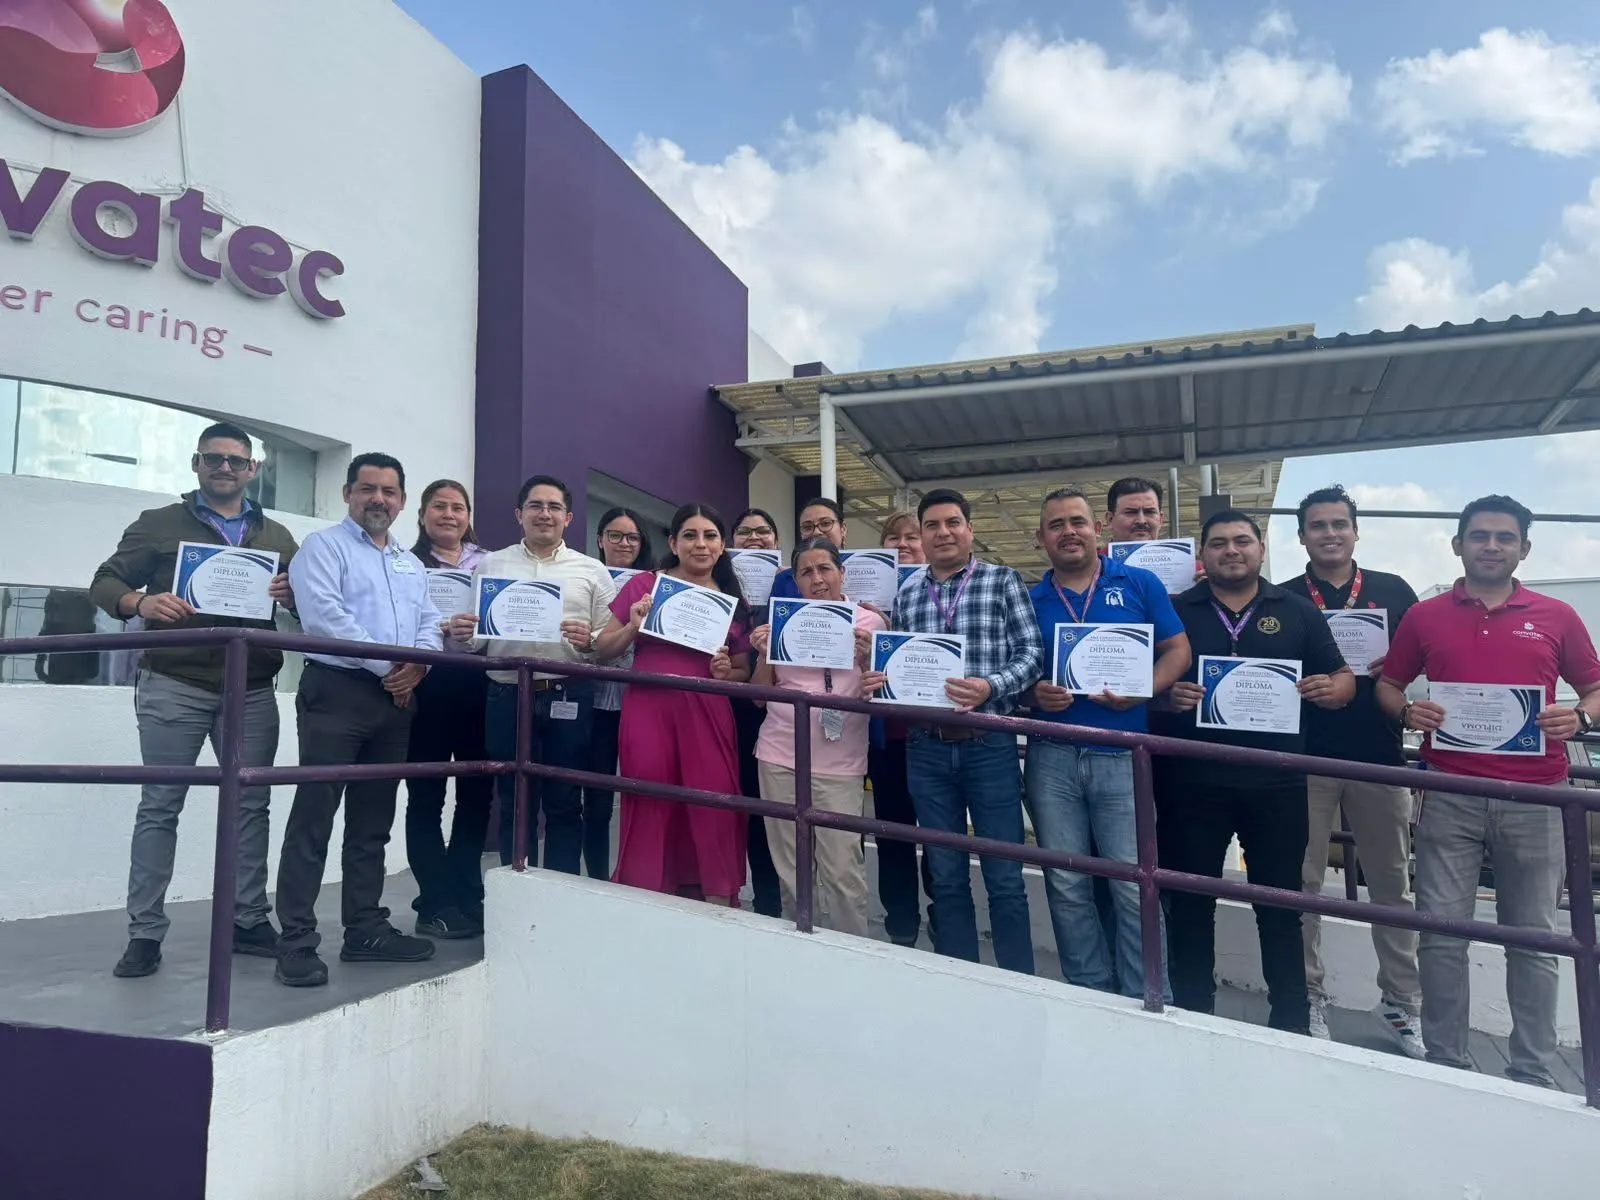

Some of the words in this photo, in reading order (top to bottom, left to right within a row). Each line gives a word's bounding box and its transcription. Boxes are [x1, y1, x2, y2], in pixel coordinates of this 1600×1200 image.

[0, 158, 346, 320] vatec
[0, 284, 52, 313] er
[76, 297, 228, 359] caring
[213, 568, 250, 577] DIPLOMA
[680, 601, 710, 615] DIPLOMA
[904, 656, 939, 664] DIPLOMA
[1235, 681, 1273, 690] DIPLOMA
[1461, 722, 1502, 731] DIPLOMA
